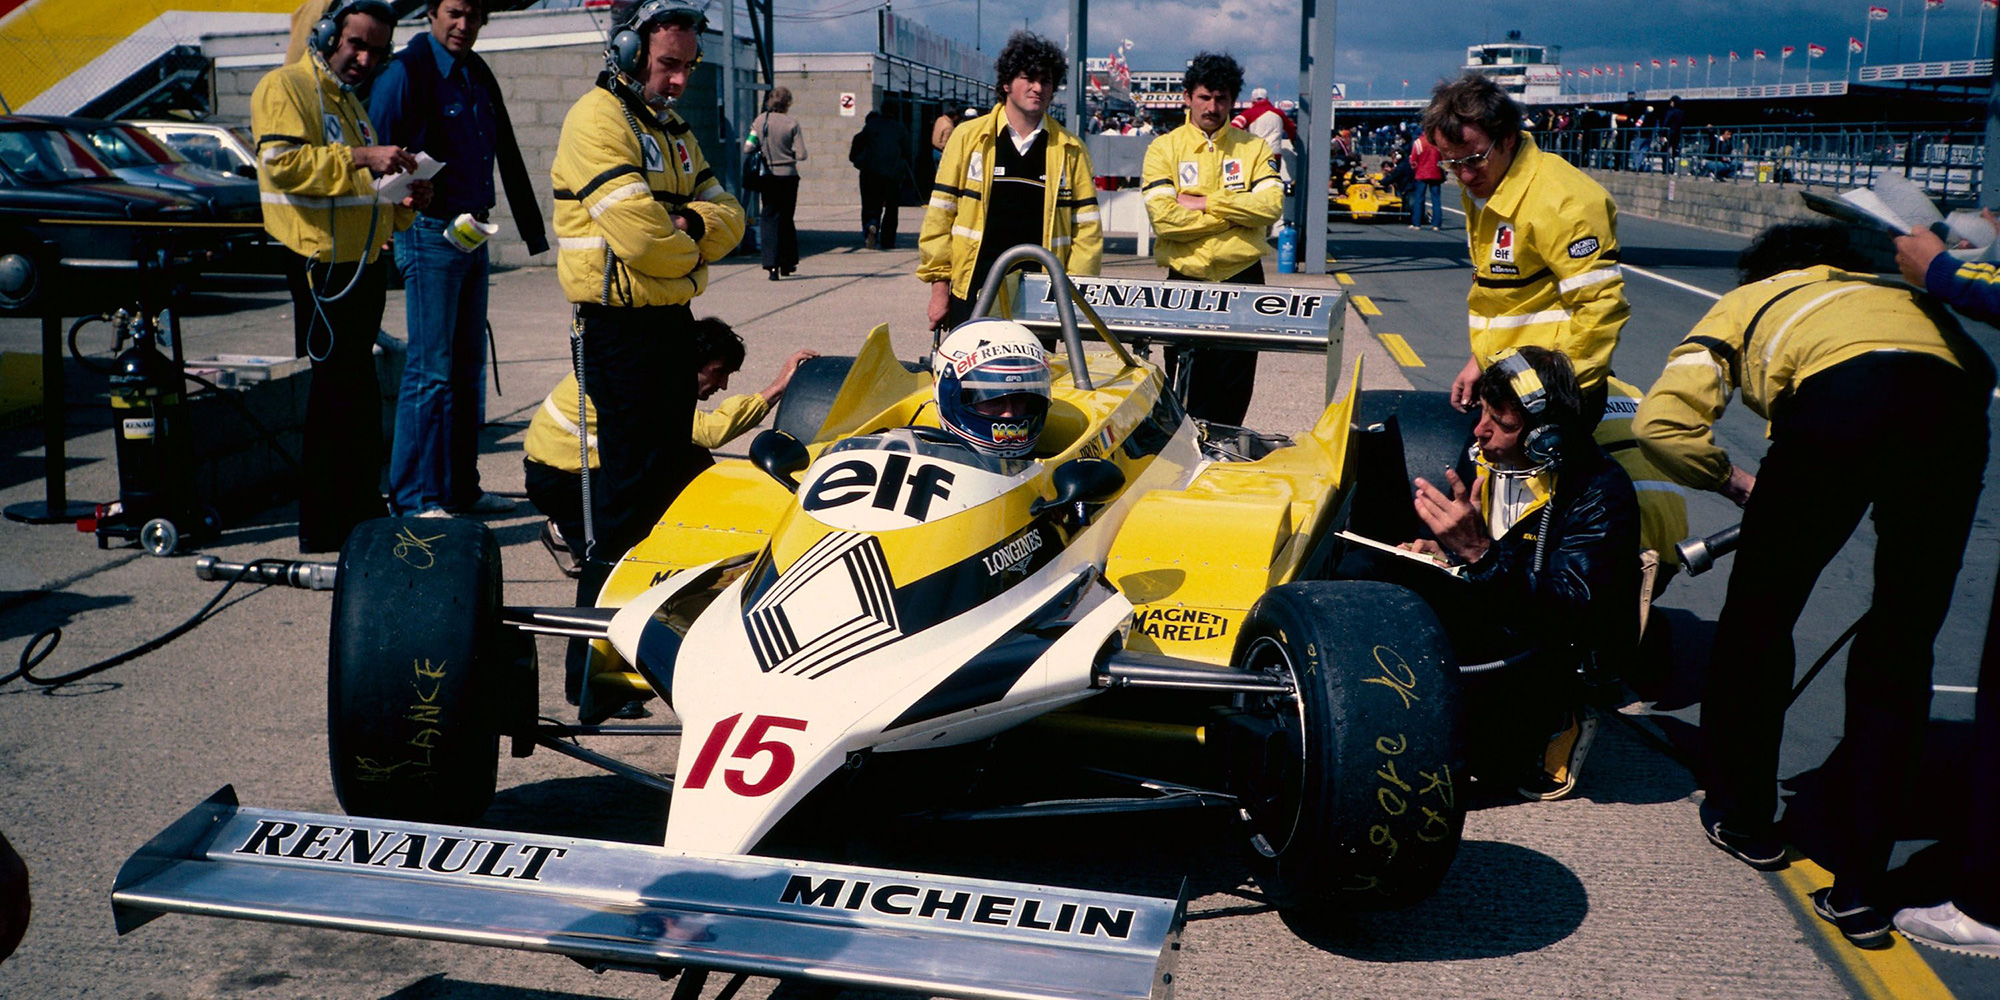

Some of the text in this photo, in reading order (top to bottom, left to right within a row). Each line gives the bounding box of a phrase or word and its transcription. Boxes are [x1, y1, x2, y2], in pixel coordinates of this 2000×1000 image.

[1226, 174, 1239, 182] elf
[1495, 249, 1510, 260] elf
[1252, 293, 1323, 319] elf
[957, 344, 1042, 374] elf RENAULT
[802, 454, 957, 523] elf
[982, 528, 1042, 577] LONGINES
[1131, 608, 1228, 632] MAGNETI
[1131, 621, 1228, 641] MARELLI
[683, 712, 808, 798] 15
[236, 819, 567, 882] RENAULT
[779, 874, 1138, 939] MICHELIN
